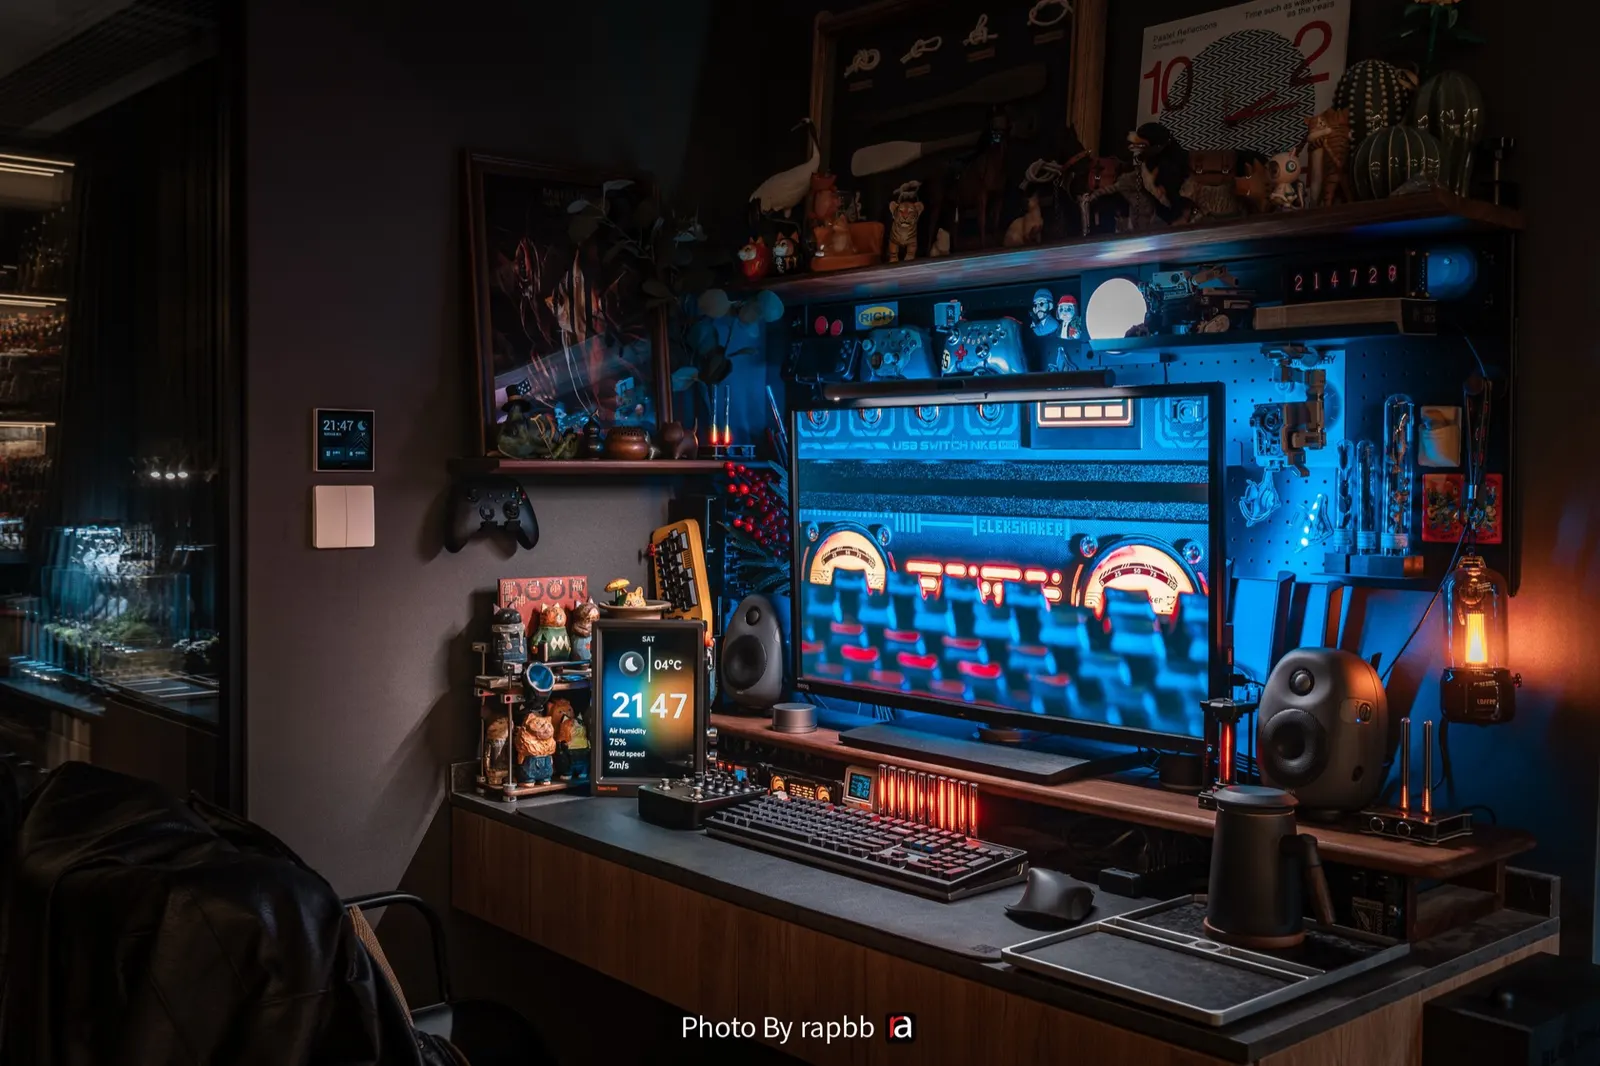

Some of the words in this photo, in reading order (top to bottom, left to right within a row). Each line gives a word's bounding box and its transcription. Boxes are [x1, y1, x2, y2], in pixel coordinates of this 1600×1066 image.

[1298, 6, 1311, 15] the
[1312, 1, 1335, 13] years
[1143, 56, 1193, 115] 10
[860, 310, 893, 323] RICH
[323, 419, 354, 431] 21:47
[893, 440, 918, 451] USB
[920, 439, 969, 451] SWITCH
[641, 635, 655, 643] SAT
[609, 727, 618, 735] Air
[619, 727, 647, 735] humidity
[609, 738, 627, 746] 75%
[626, 750, 645, 758] speed
[609, 761, 630, 770] 2m/s
